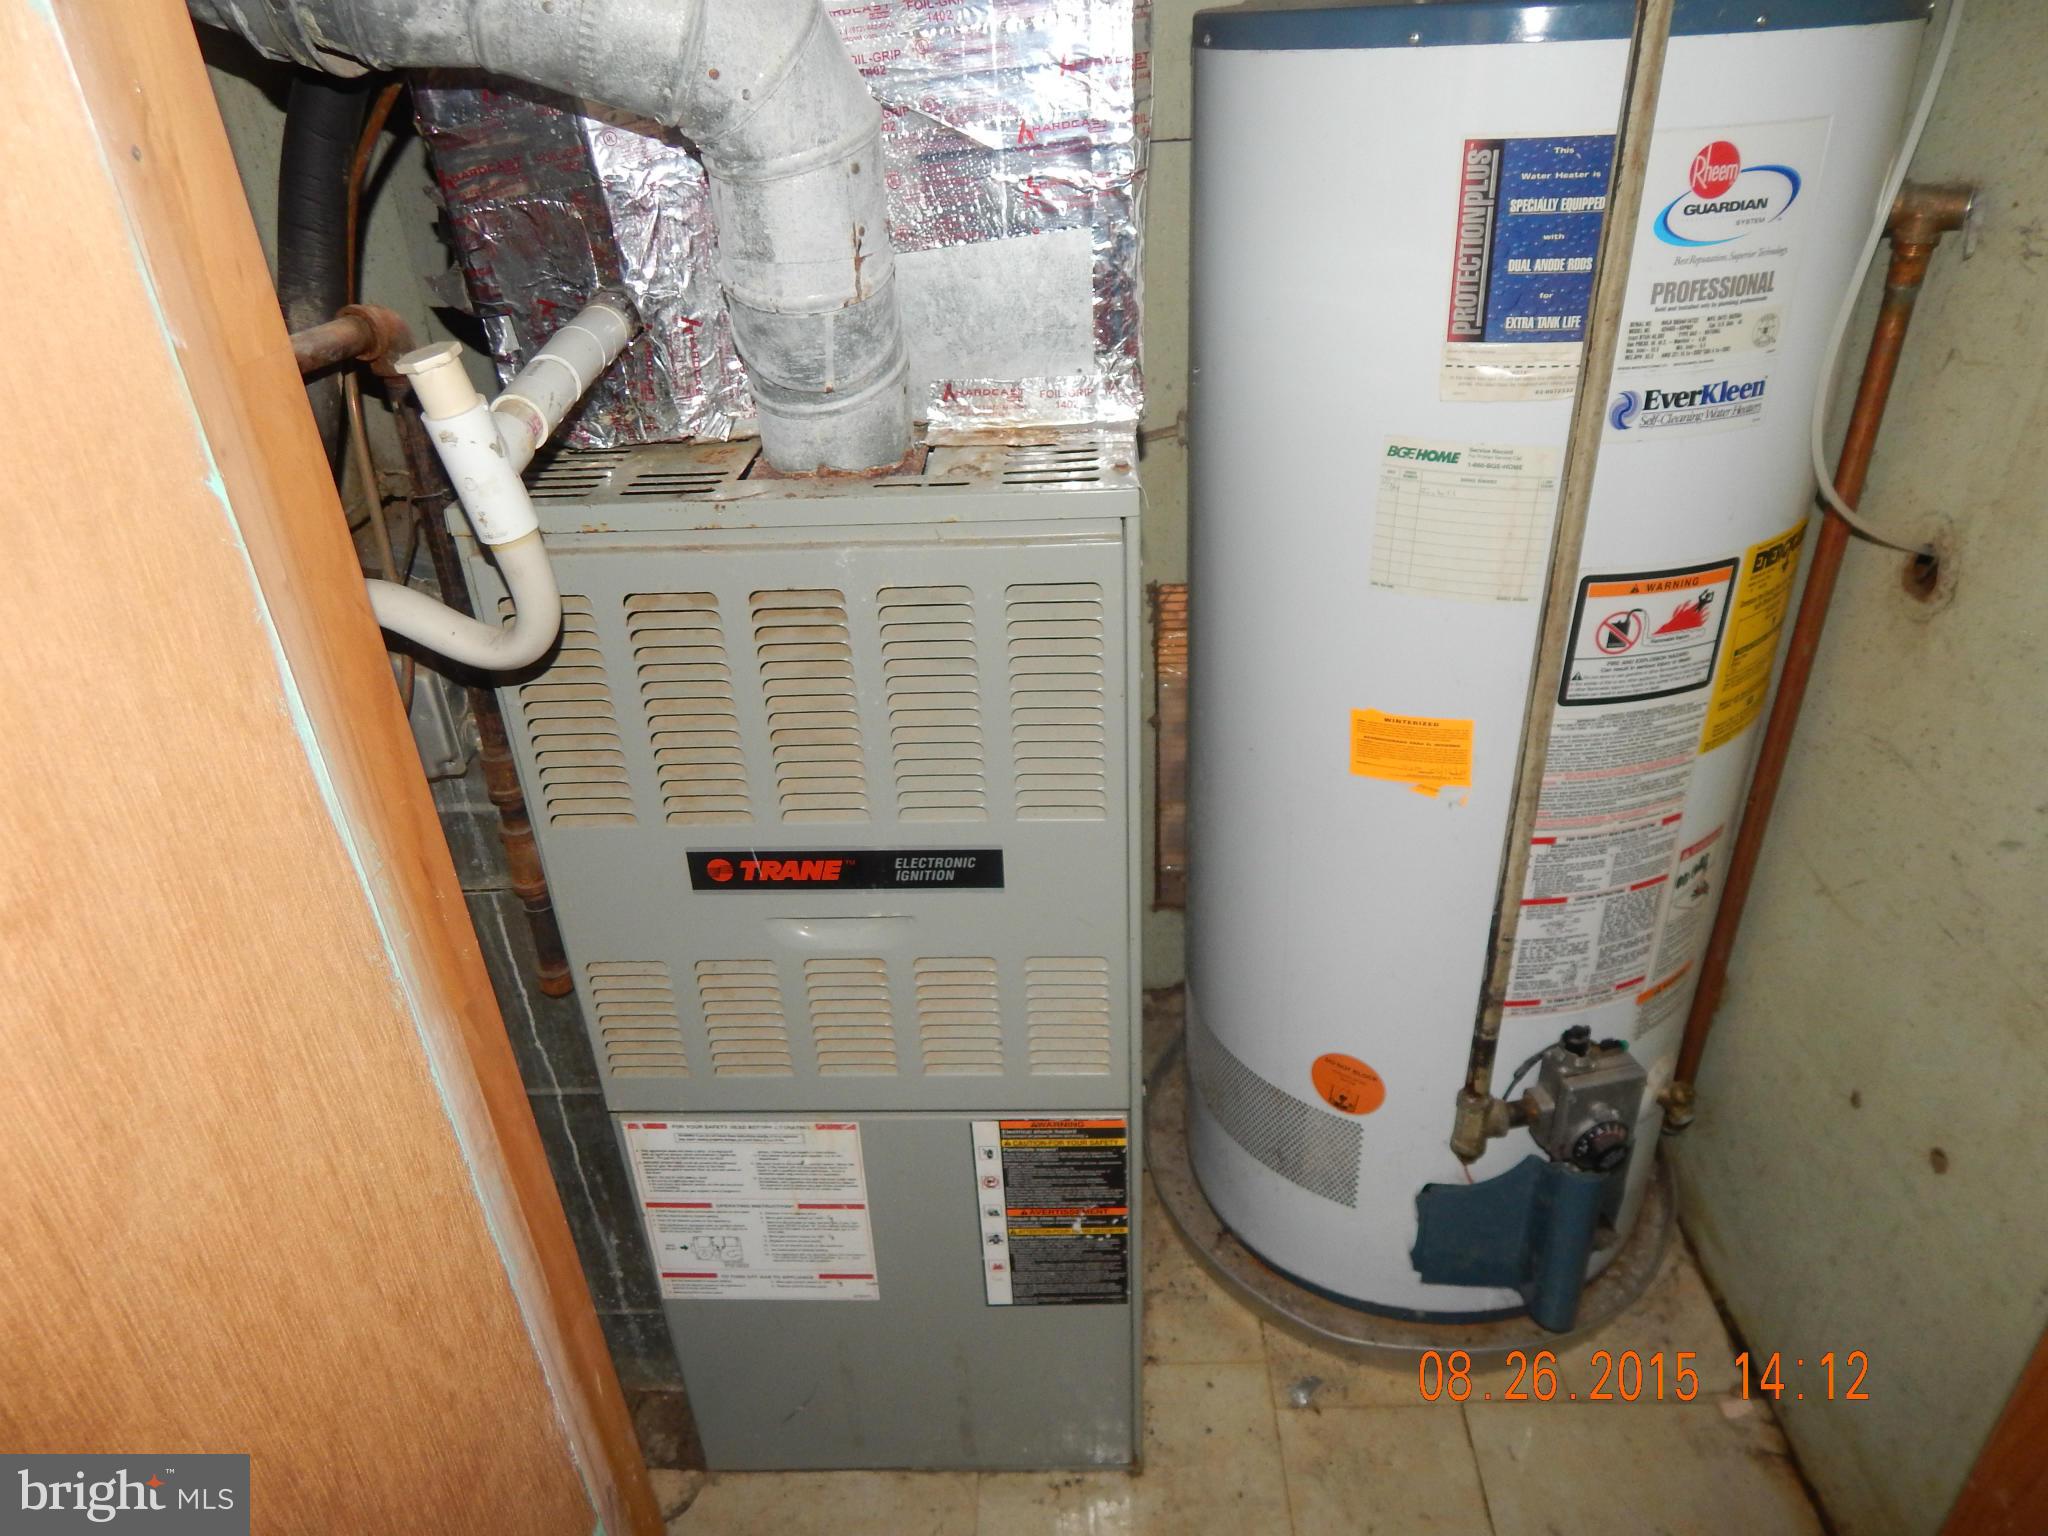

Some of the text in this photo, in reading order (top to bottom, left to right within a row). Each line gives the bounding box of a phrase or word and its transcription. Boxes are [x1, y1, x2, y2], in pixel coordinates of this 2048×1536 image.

[926, 10, 953, 22] 1402
[1554, 146, 1575, 154] This
[1692, 144, 1739, 189] Rheem
[1521, 172, 1552, 180] Water
[1555, 171, 1590, 179] Heater
[1509, 196, 1606, 213] SPECIALLY EQUIPPED
[1683, 198, 1769, 216] GUARDIAN
[1736, 217, 1766, 226] SYSTEM
[1508, 257, 1594, 272] DUAL ANODE RODS
[1650, 270, 1775, 305] PROFESSIONAL
[1539, 291, 1554, 299] for
[1505, 315, 1582, 329] EXTRA TANK LIFE
[1642, 379, 1767, 412] EverKleen
[1705, 406, 1731, 419] Water
[1646, 577, 1700, 594] WARNING
[895, 856, 976, 869] ELECTRONIC
[740, 859, 843, 881] TRANE
[896, 870, 956, 881] IGNITION
